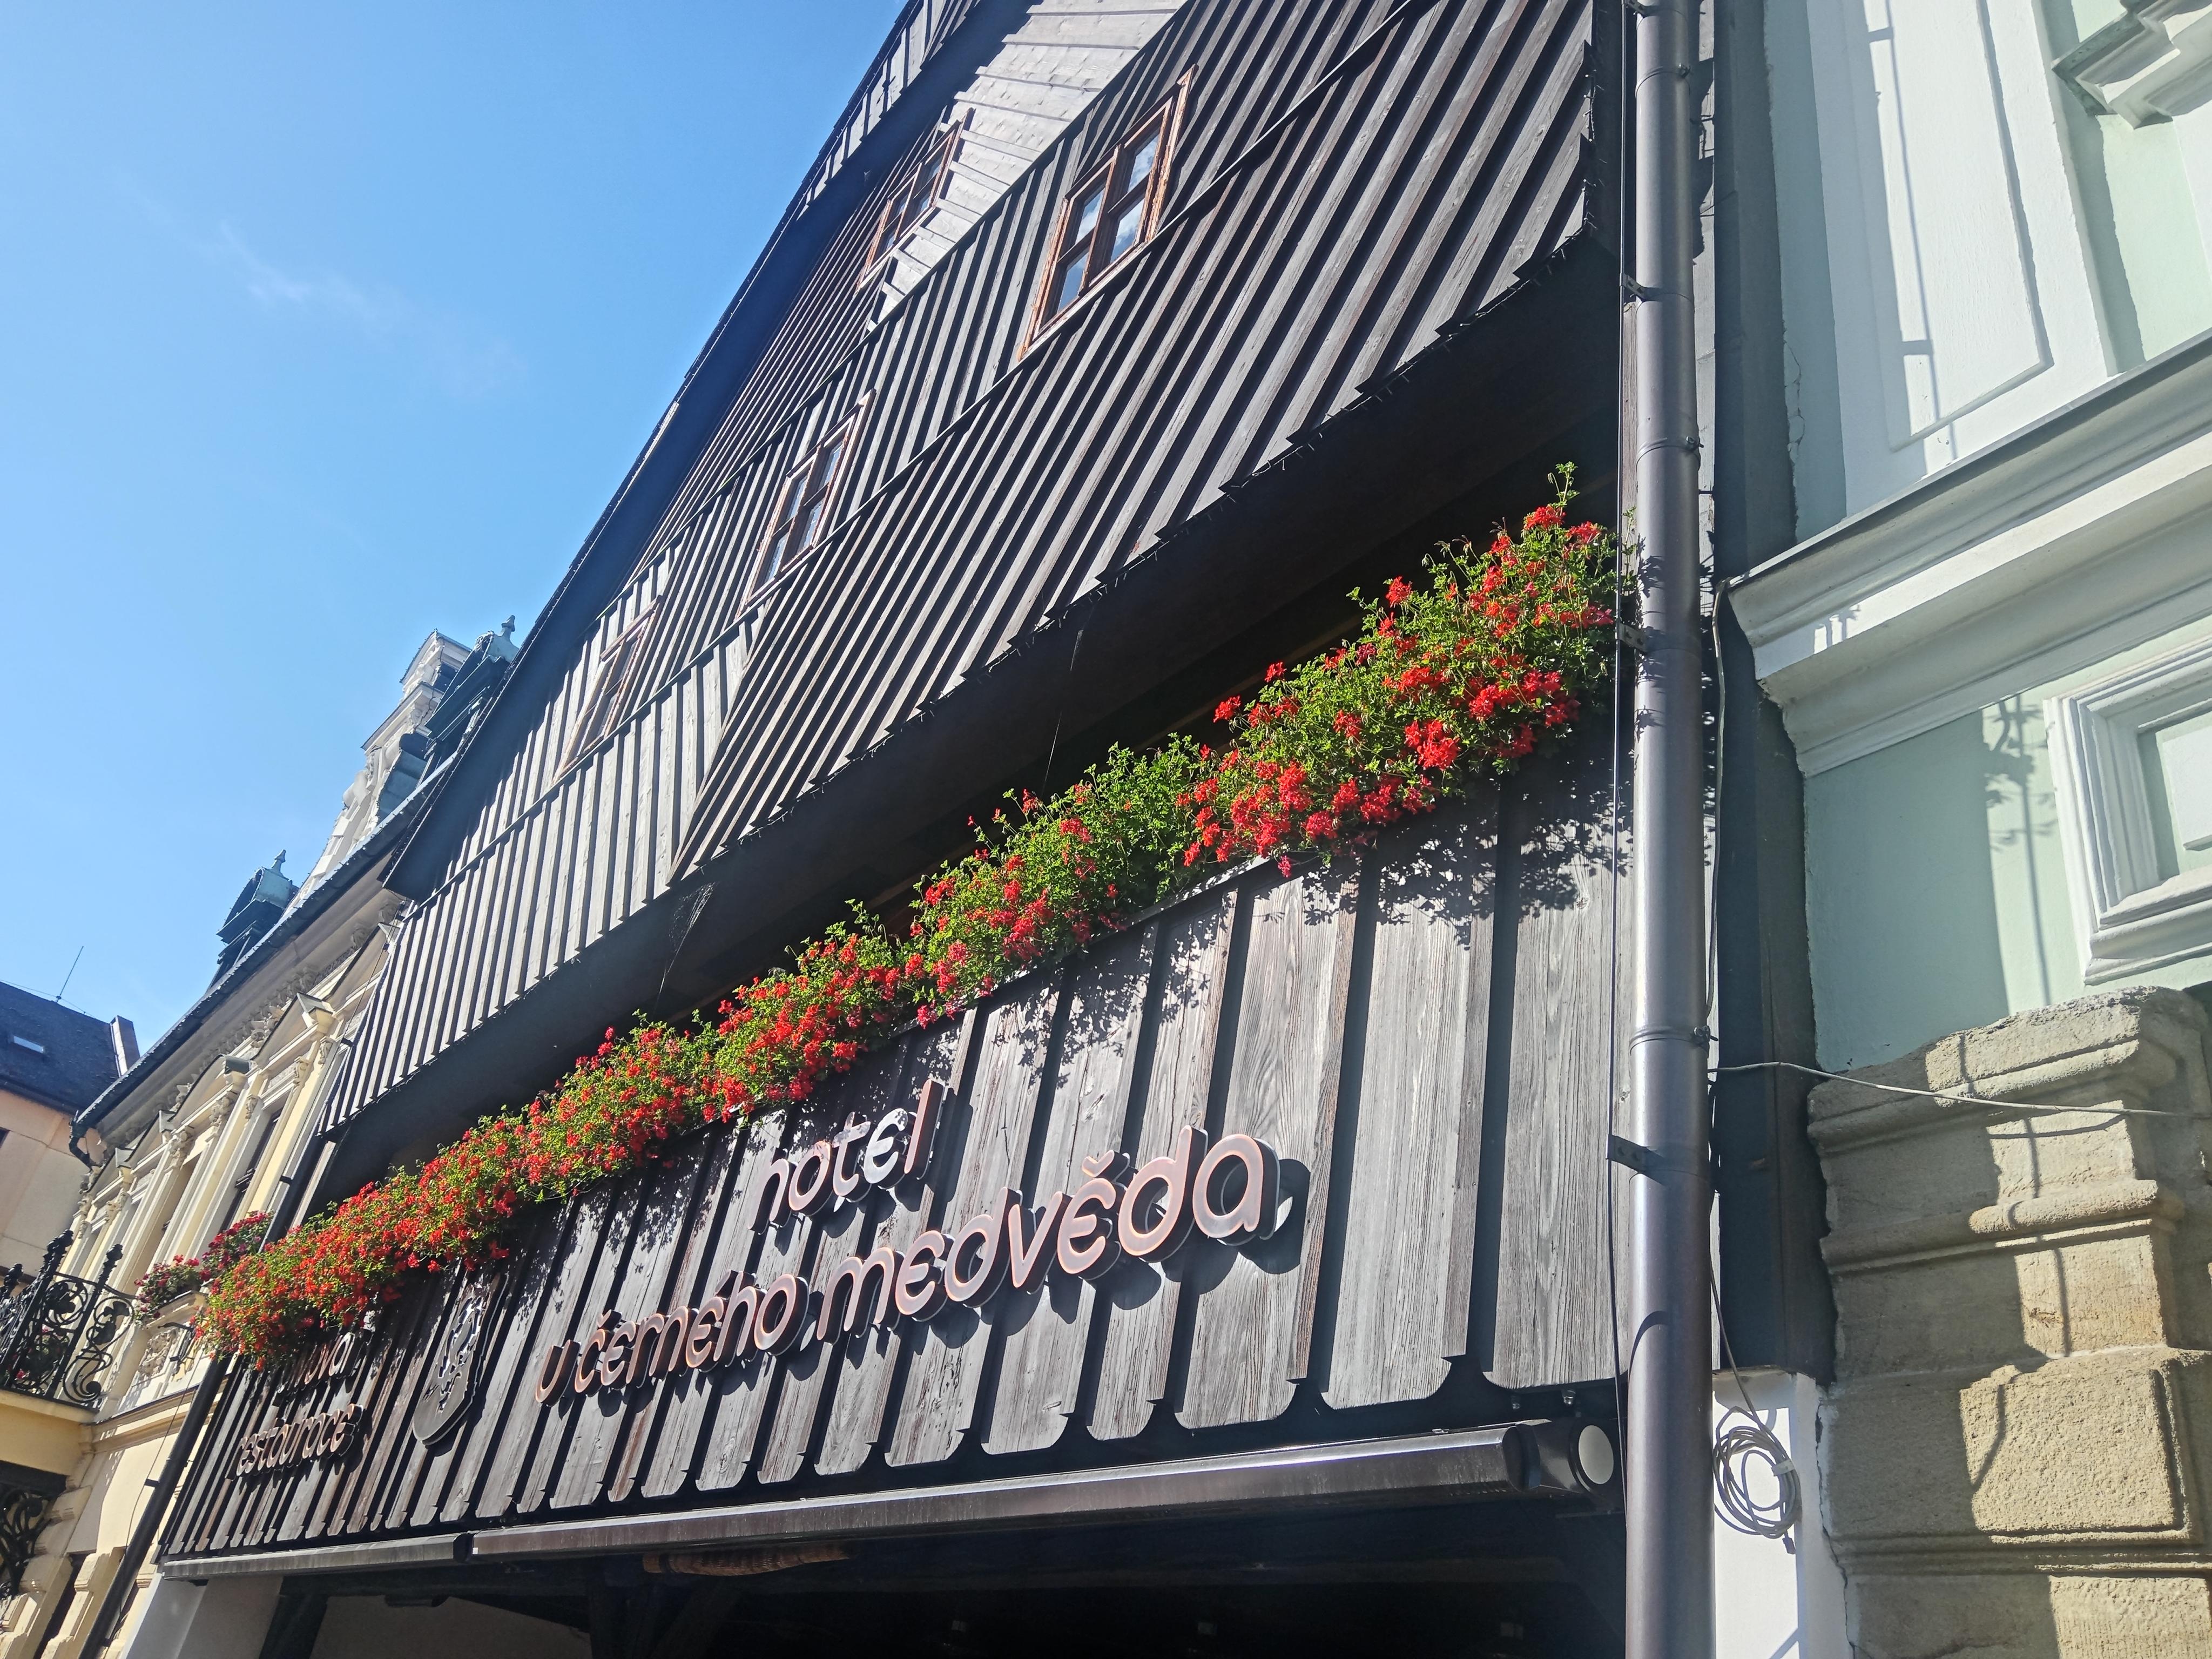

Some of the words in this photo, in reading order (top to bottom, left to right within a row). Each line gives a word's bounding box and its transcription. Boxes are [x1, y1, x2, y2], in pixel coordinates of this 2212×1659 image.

[748, 1078, 938, 1231] hotel
[535, 1340, 577, 1404] u
[574, 1270, 801, 1394] černého
[817, 1125, 1269, 1342] medvěda
[231, 1403, 359, 1480] restaurace
